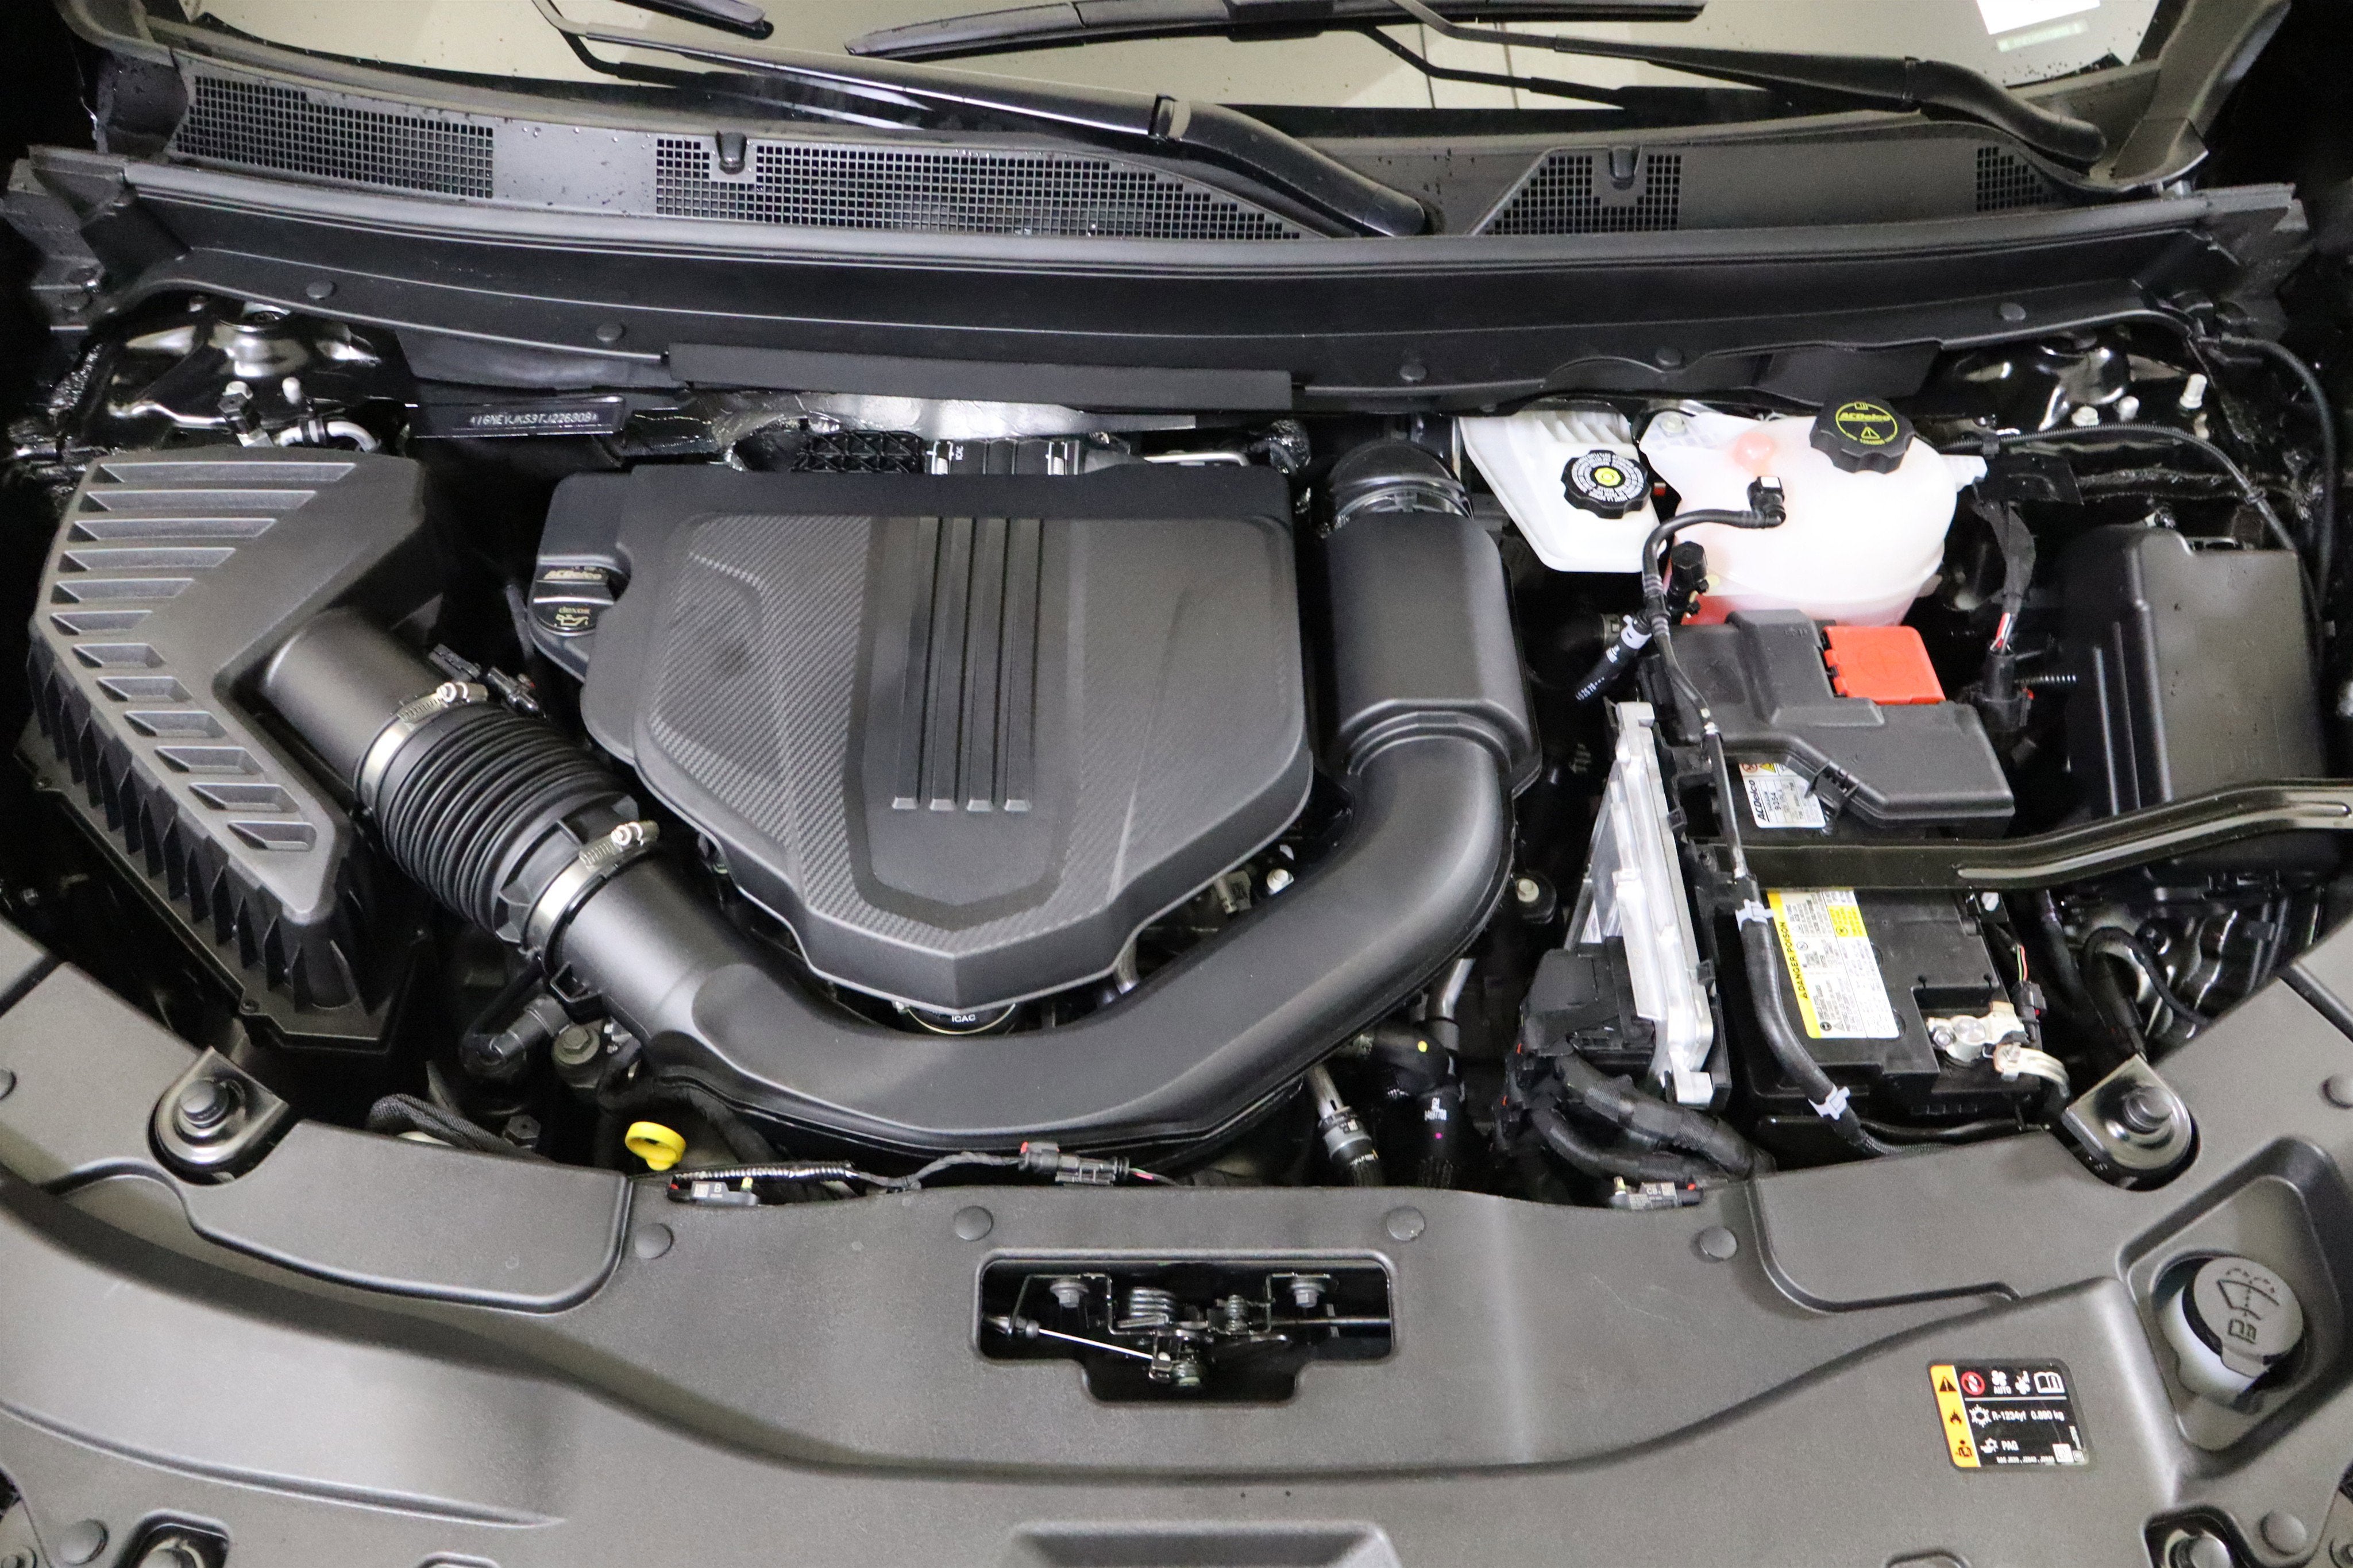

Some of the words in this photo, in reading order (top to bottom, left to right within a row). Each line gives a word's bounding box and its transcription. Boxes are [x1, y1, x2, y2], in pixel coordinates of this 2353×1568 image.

[1838, 412, 1891, 422] ACDelco
[1749, 779, 1766, 820] ACDelco
[1780, 921, 1793, 952] POISON
[1789, 956, 1806, 992] DANGER
[1993, 1386, 2012, 1395] AUTO
[1992, 1409, 2026, 1422] R-1234yf
[2053, 1409, 2065, 1422] kg
[2001, 1440, 2019, 1451] PAG
